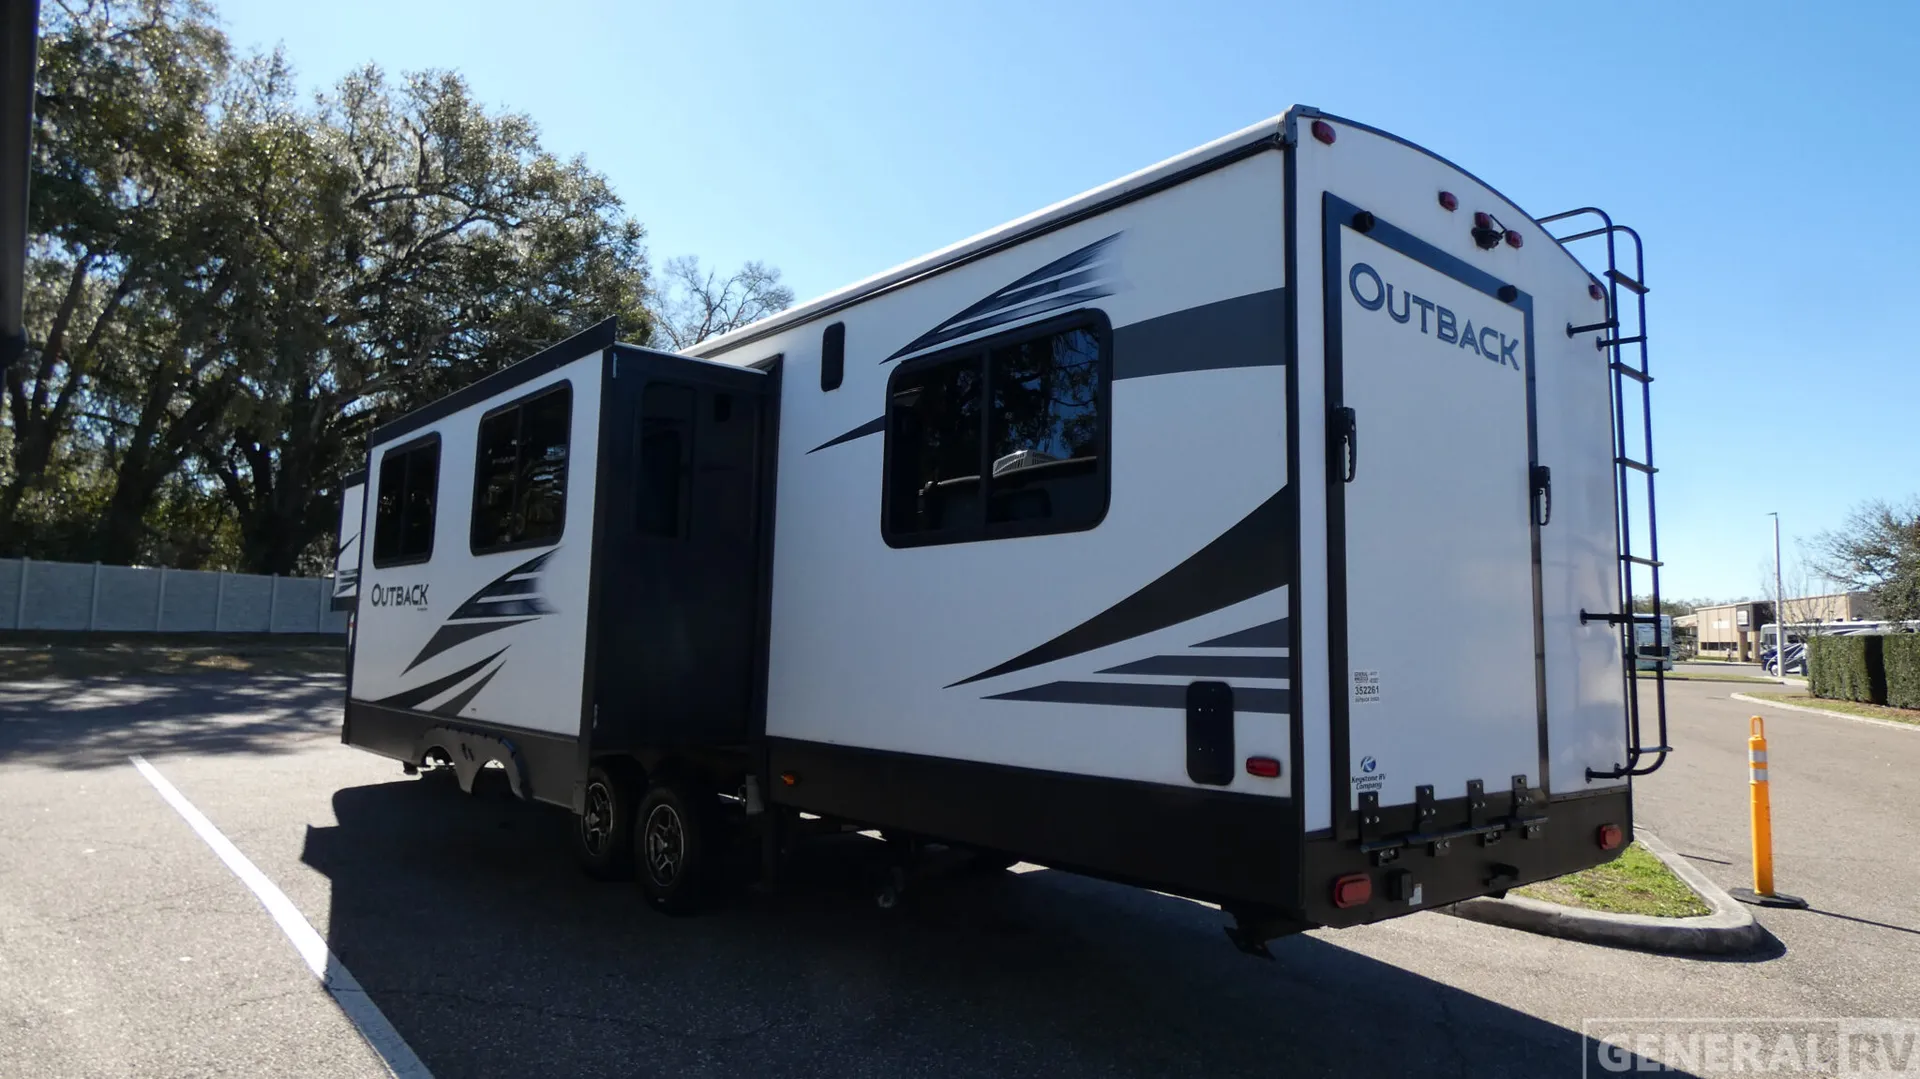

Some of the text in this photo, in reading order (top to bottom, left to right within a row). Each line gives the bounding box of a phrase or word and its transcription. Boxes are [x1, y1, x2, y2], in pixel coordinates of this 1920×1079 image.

[1349, 262, 1520, 371] OUTBACK
[371, 583, 429, 607] OUTBACK
[1354, 685, 1379, 695] 352261
[1351, 773, 1386, 784] Keystone RV
[1356, 782, 1382, 790] Company
